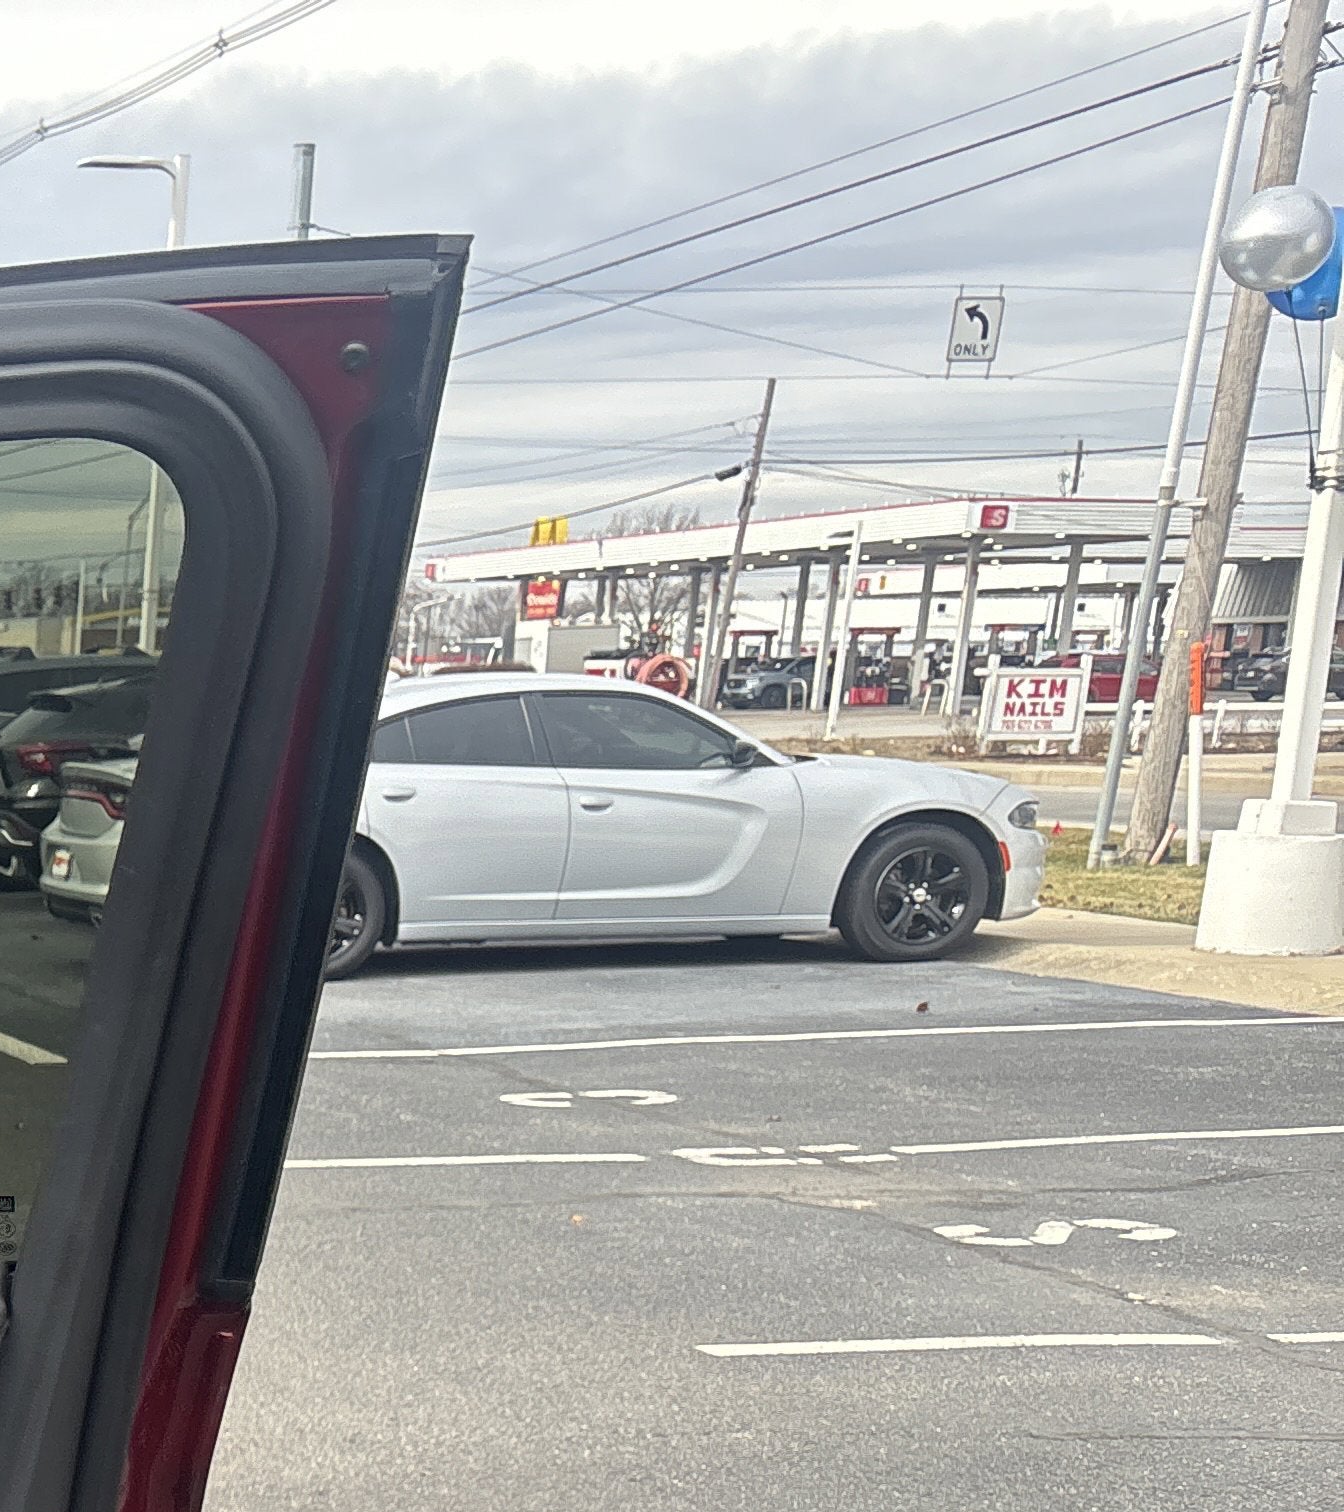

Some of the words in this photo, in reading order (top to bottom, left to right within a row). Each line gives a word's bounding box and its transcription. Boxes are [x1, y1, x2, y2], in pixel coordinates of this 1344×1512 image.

[953, 343, 990, 357] ONLY
[1006, 678, 1068, 699] KIM
[1003, 701, 1066, 717] NAILS
